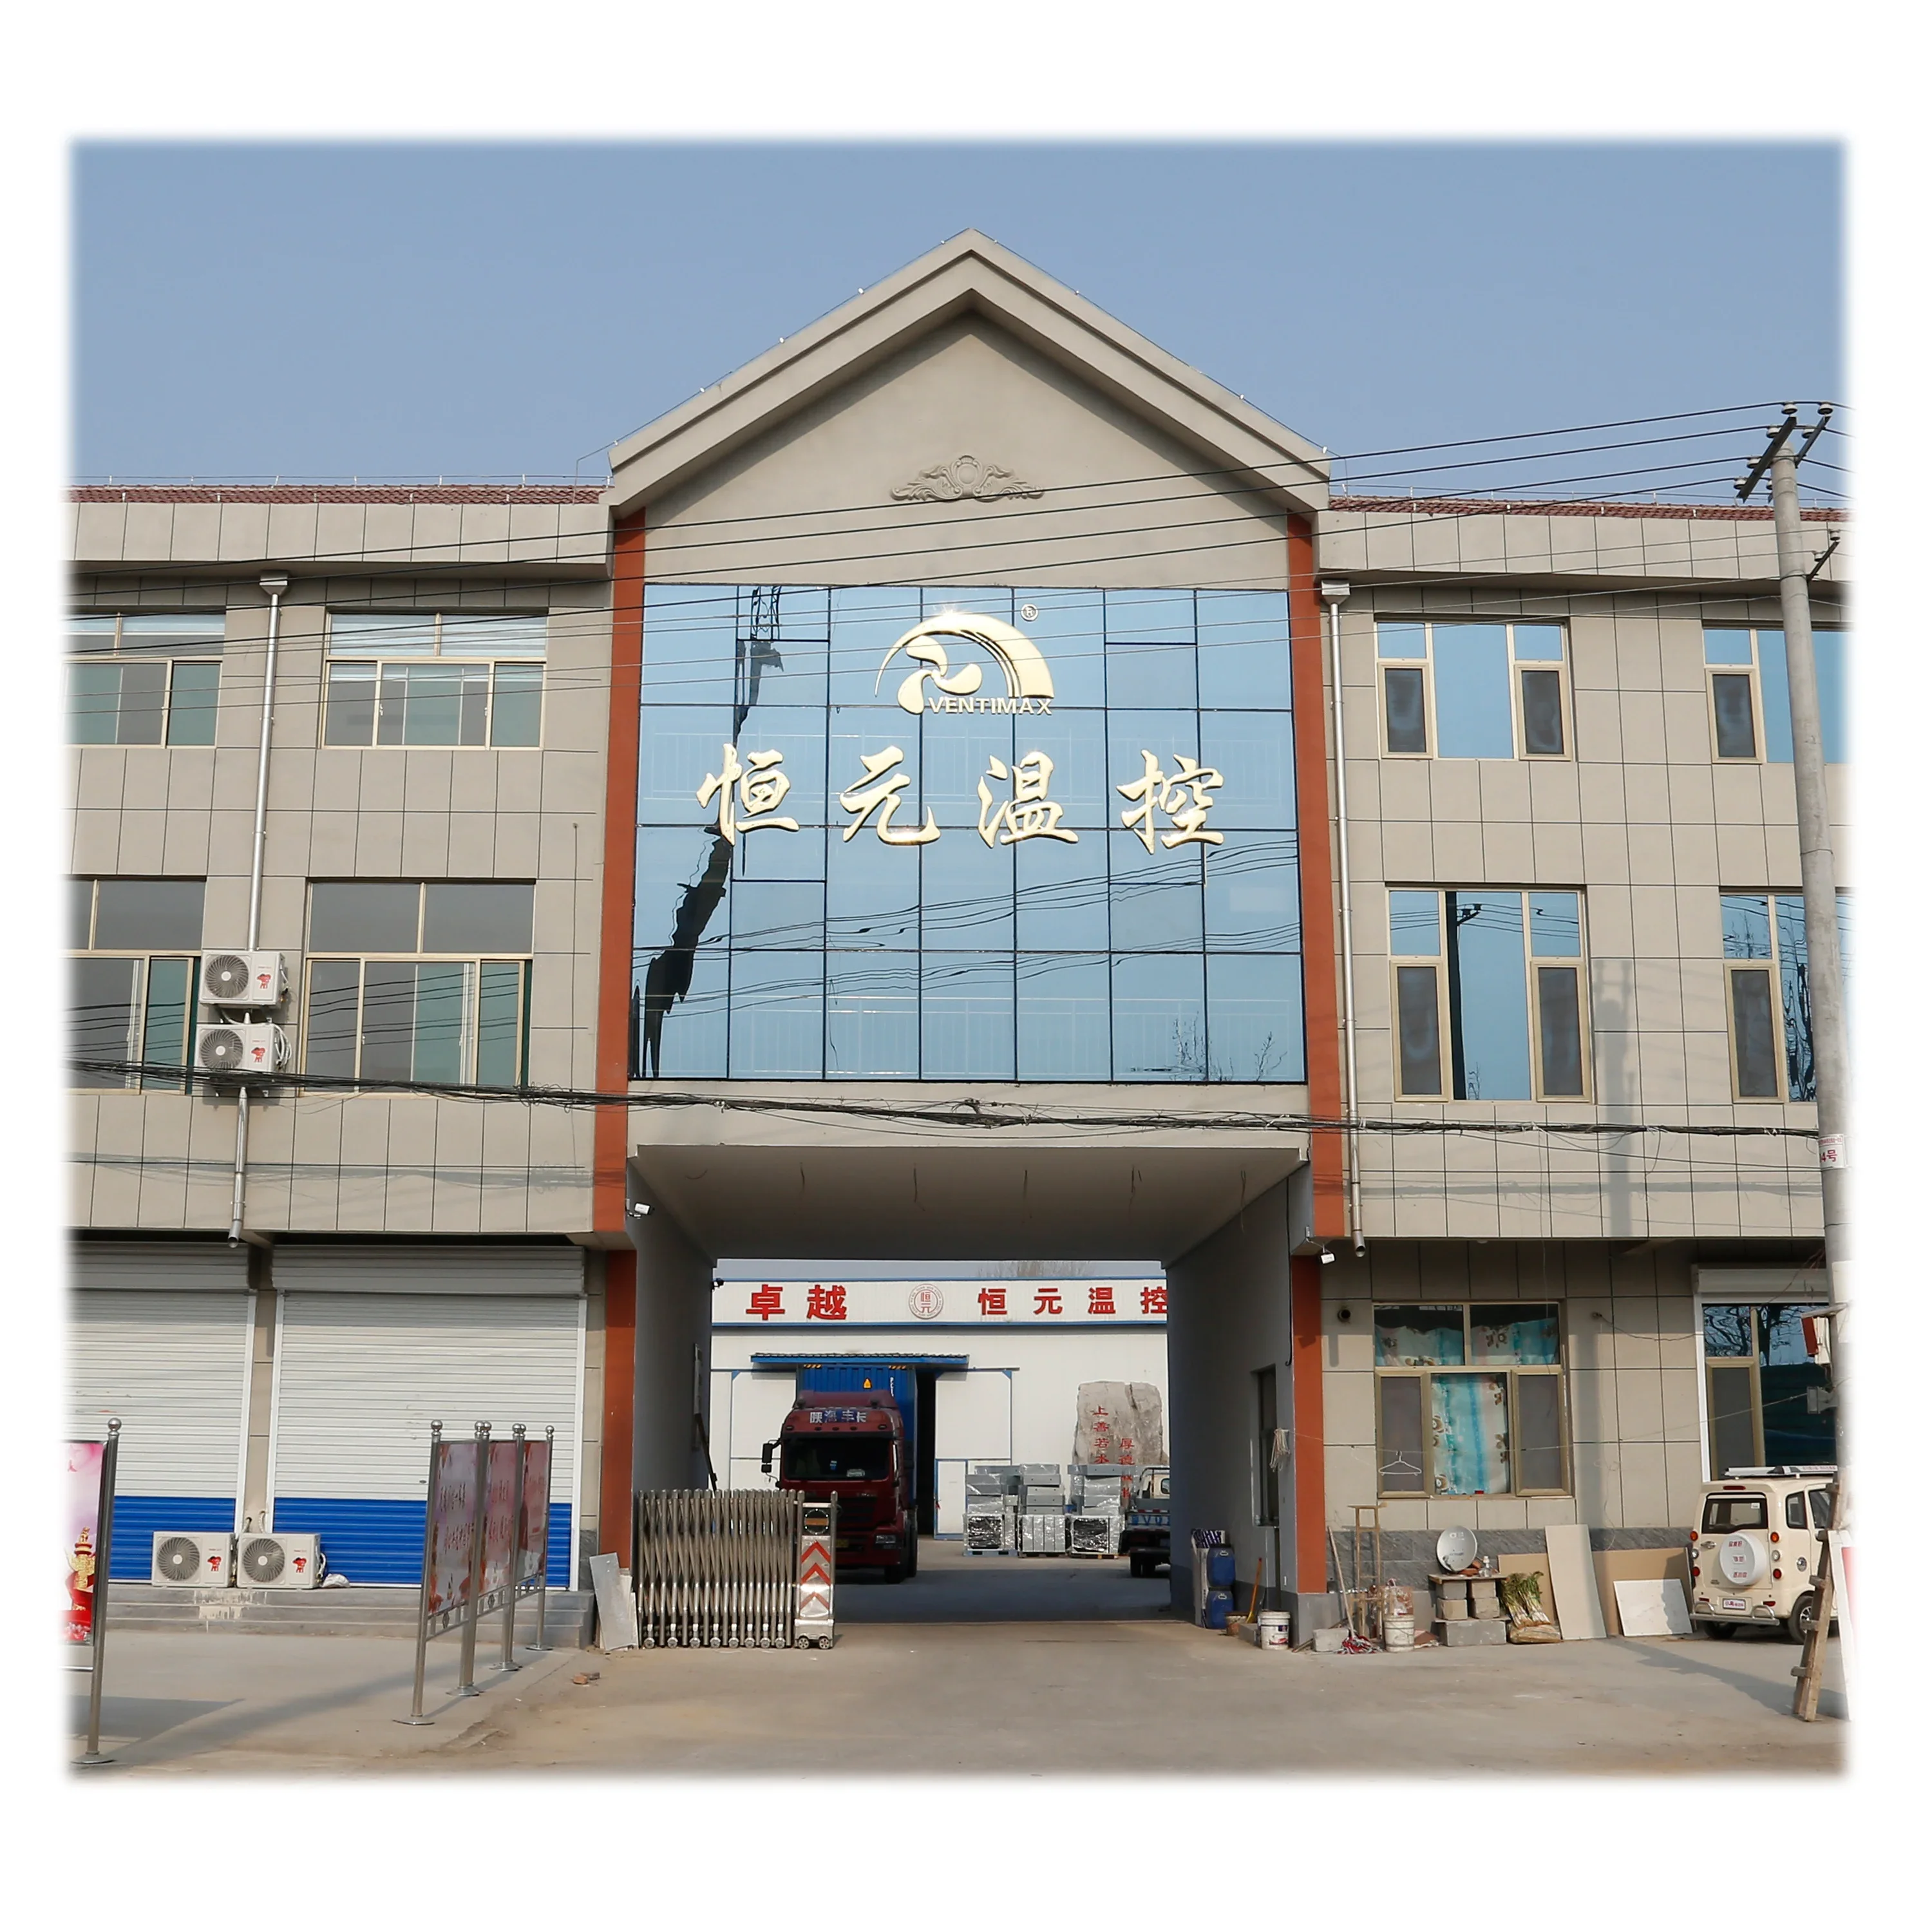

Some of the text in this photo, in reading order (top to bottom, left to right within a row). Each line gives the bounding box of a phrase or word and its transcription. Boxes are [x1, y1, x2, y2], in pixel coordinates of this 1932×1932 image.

[928, 697, 1052, 715] VENTIMAX
[696, 743, 1225, 855] 恒元温控
[746, 1283, 847, 1320] 卓越
[920, 1291, 931, 1313] 恒元
[978, 1286, 1167, 1315] 恒元温控
[1092, 1405, 1110, 1464] 上善若水
